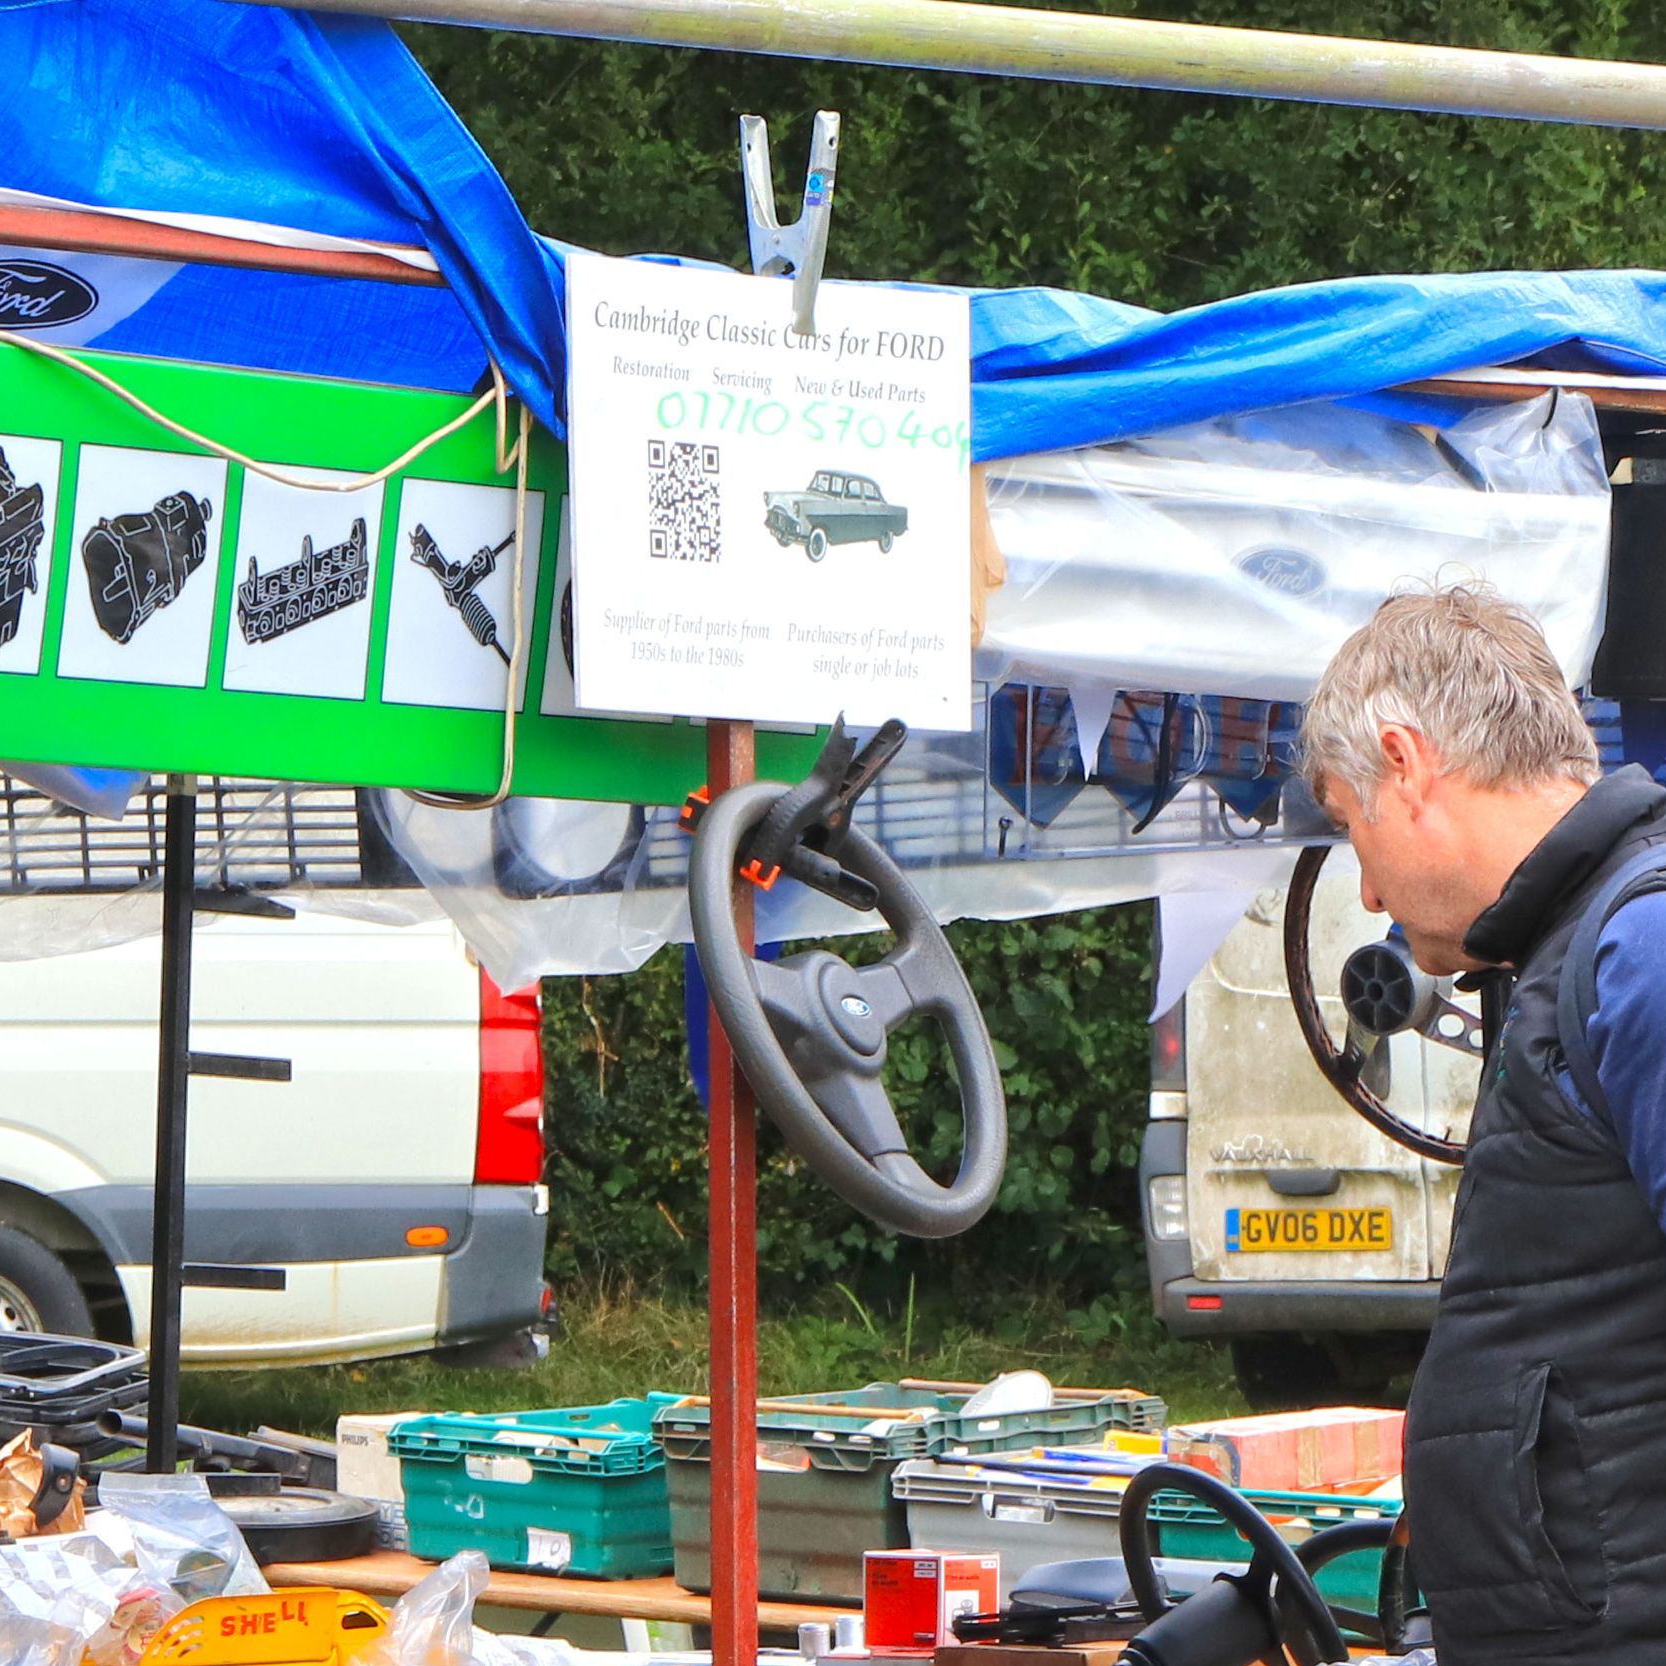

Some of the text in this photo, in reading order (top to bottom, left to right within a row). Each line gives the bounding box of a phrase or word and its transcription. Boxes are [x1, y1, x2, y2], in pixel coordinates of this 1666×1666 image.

[594, 301, 701, 346] Cambridge
[707, 313, 777, 349] Classic
[838, 328, 870, 360] for
[876, 330, 945, 363] FORD
[613, 356, 927, 405] Restoration Servicing New & Used Parts
[657, 392, 790, 435] 07710
[799, 402, 888, 450] 570
[1255, 554, 1309, 593] Ford
[604, 608, 771, 642] Supplier of Ford parts from
[787, 623, 945, 654] Purchasers of Ford parts
[631, 641, 745, 669] 1950s to the 1980s
[813, 656, 919, 682] single or job lots
[1211, 1147, 1315, 1162] VAUXHALL
[1244, 1211, 1386, 1245] GV06 DXE
[220, 1600, 309, 1639] SHELL
